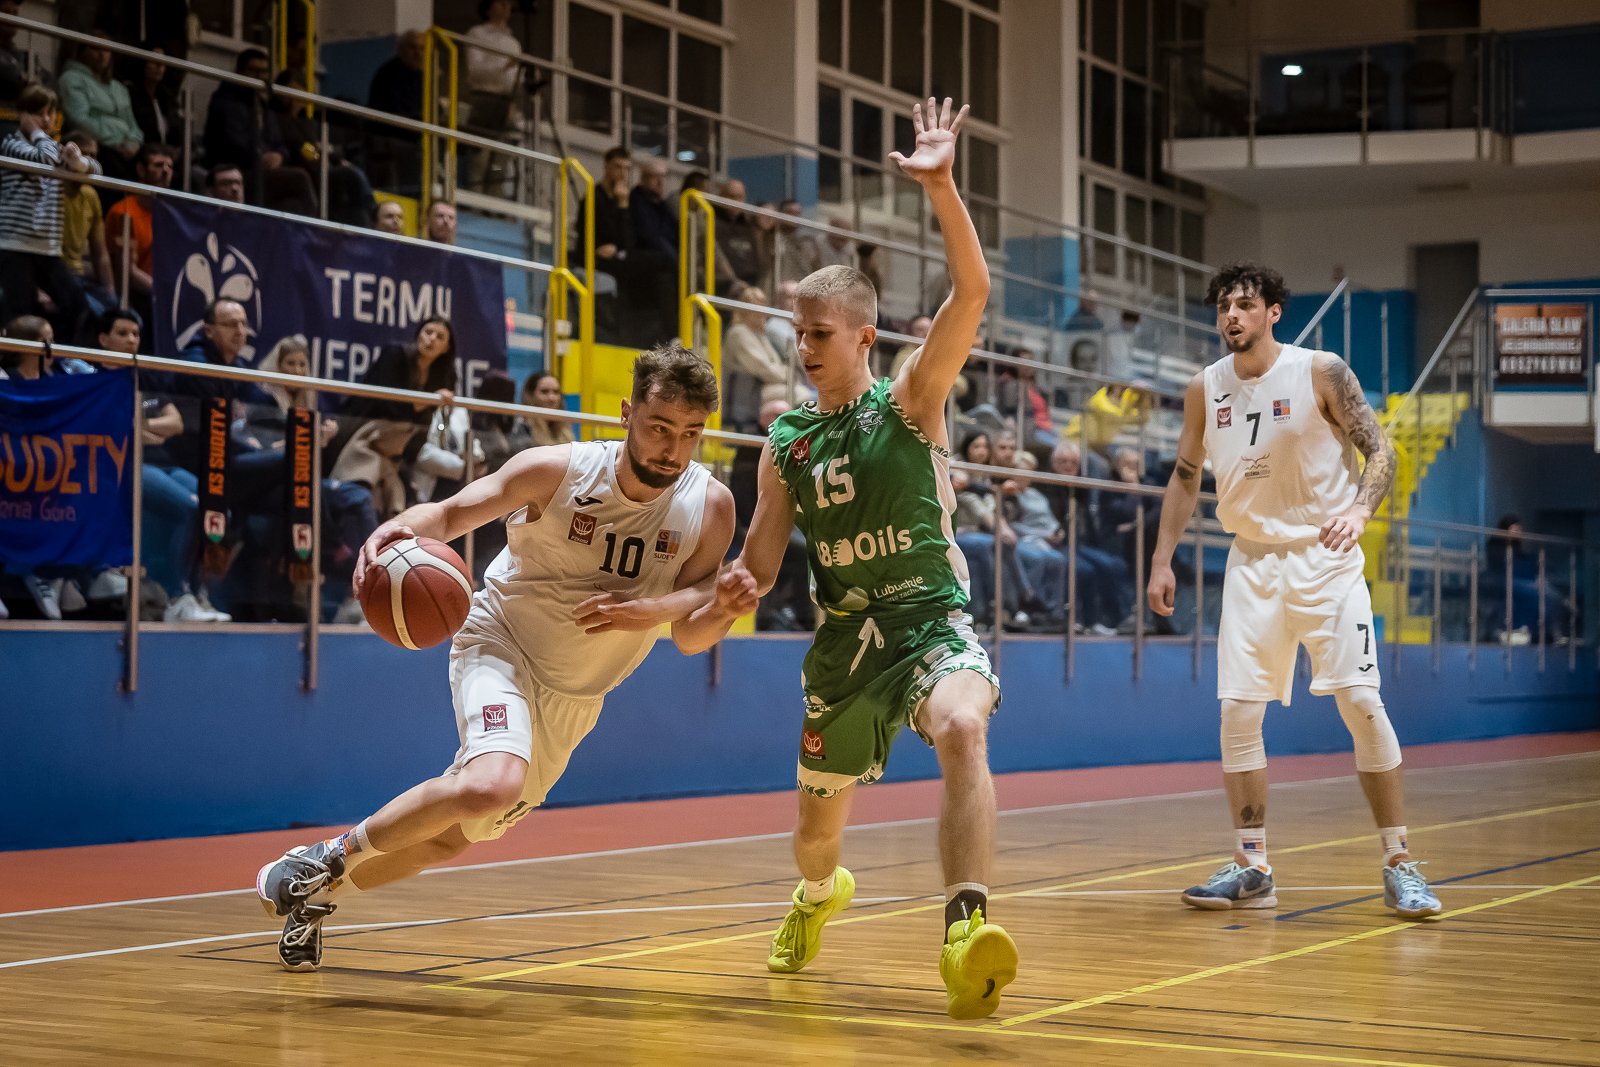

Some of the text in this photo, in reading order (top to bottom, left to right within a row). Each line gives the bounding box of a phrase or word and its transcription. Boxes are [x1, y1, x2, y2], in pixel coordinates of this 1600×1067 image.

[1246, 412, 1261, 446] 7
[0, 432, 128, 494] UDETY
[811, 454, 855, 508] 15
[599, 533, 645, 579] 10
[873, 575, 924, 599] Lubuskie
[1357, 623, 1369, 655] 7
